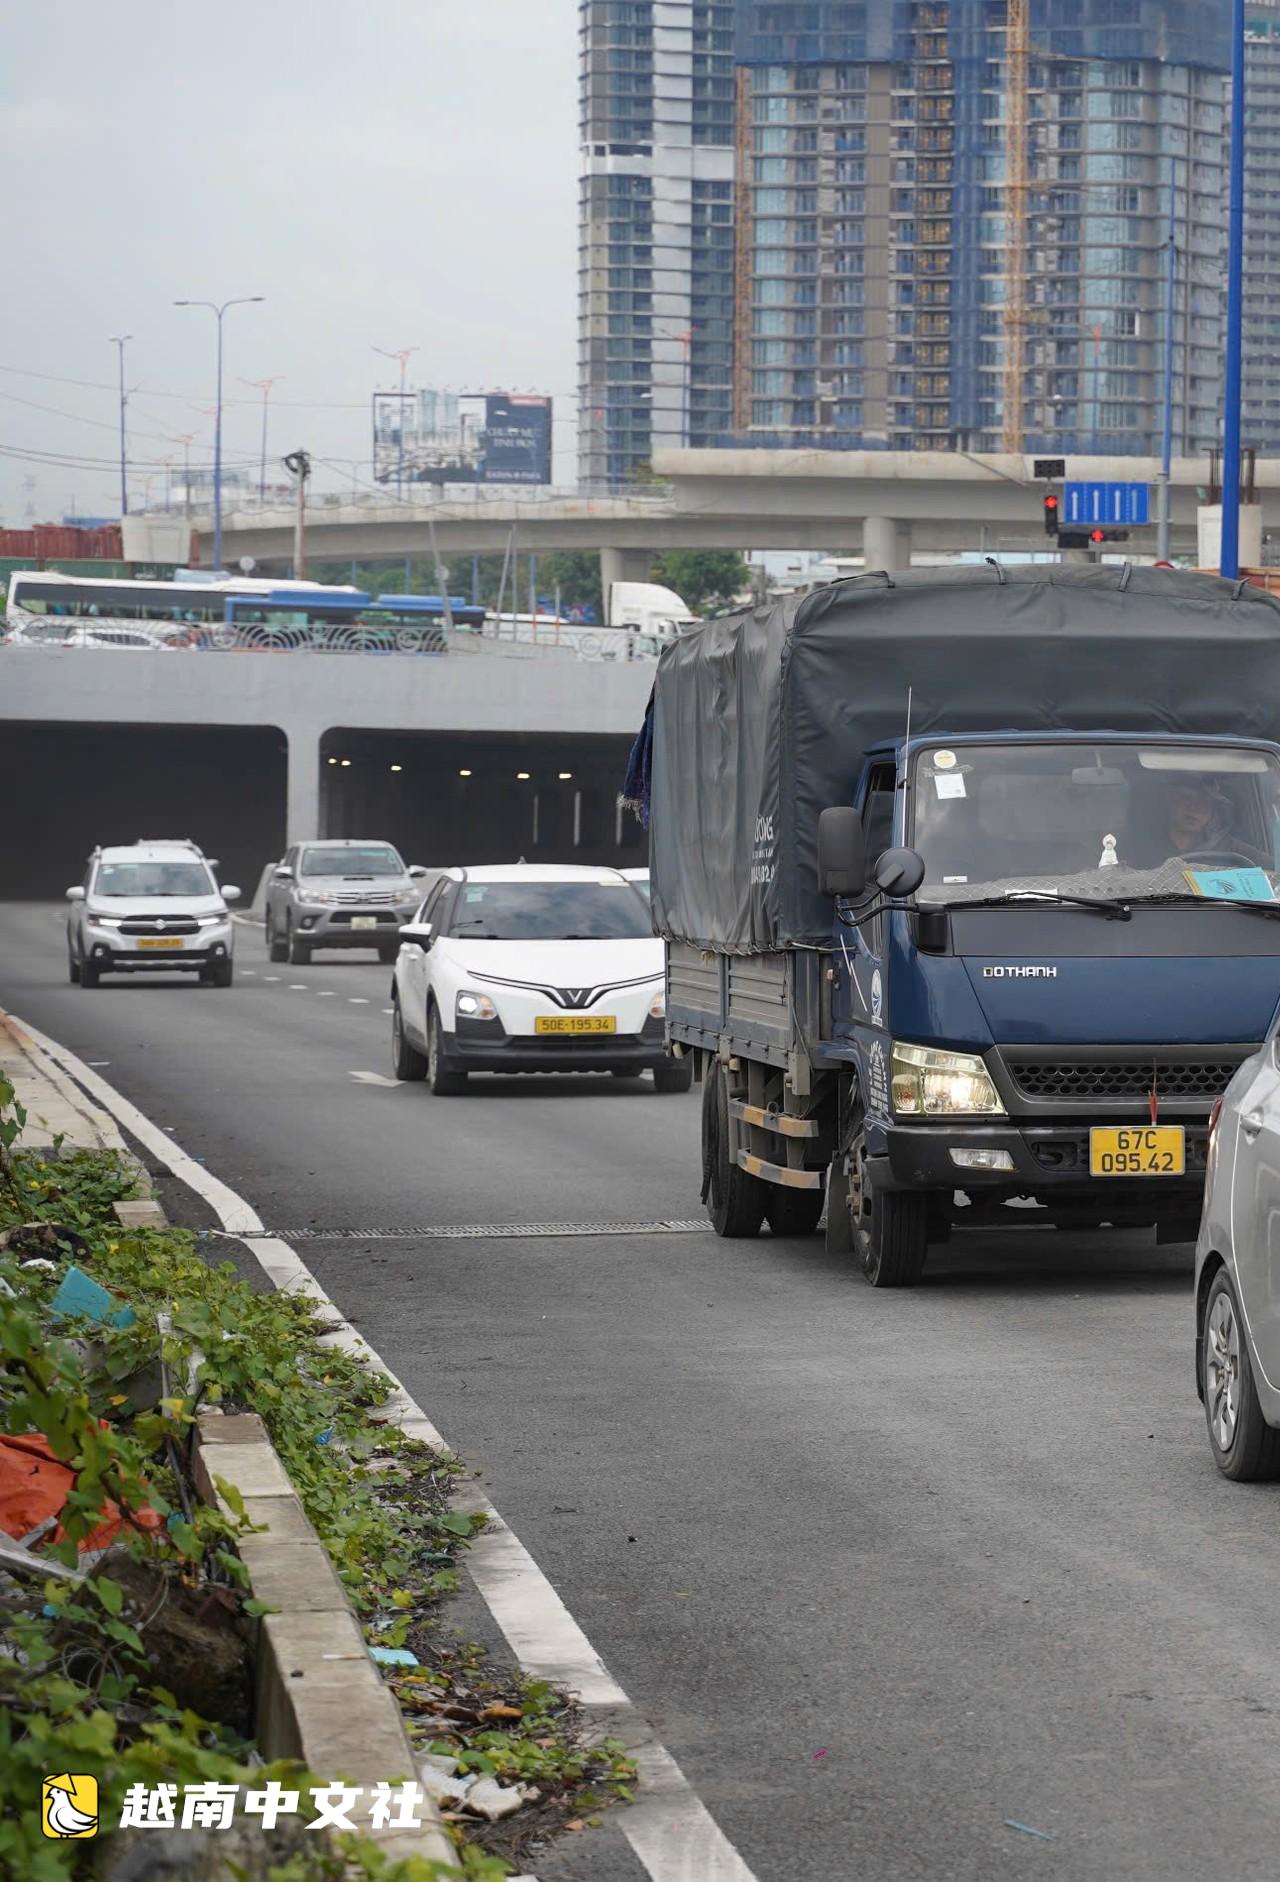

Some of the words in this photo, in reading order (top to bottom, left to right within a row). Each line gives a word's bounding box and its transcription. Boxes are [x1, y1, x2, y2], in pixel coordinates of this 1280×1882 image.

[542, 1019, 609, 1031] 50E-195.34
[1117, 1130, 1157, 1150] 67C
[1101, 1152, 1174, 1172] 095.42
